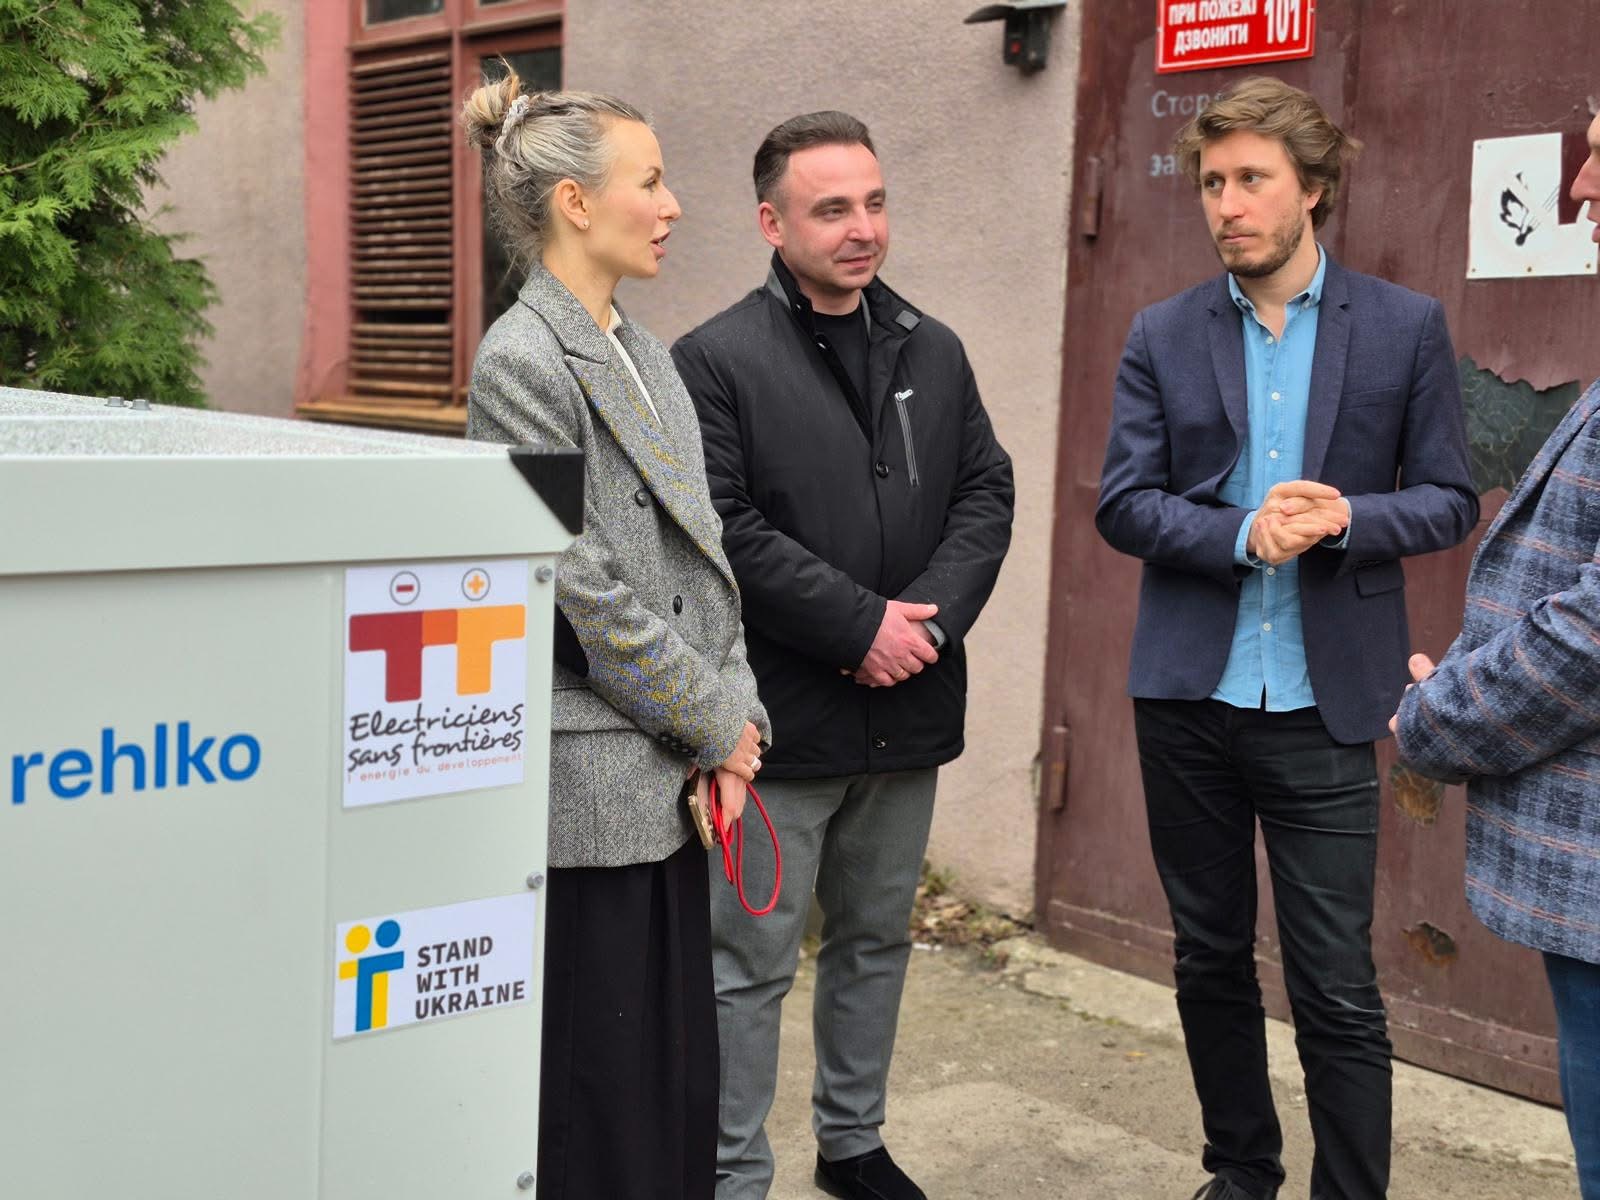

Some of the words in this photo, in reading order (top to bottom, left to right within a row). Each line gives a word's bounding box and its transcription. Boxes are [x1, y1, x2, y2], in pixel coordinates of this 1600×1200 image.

[1168, 2, 1195, 26] ПРИ
[1199, 0, 1258, 22] ПОЖЕЖІ
[1264, 0, 1301, 44] 101
[1173, 22, 1249, 56] ДЗВОНИТИ
[349, 703, 524, 741] Electriciens
[11, 720, 262, 805] rehlko
[347, 742, 404, 773] sans
[411, 727, 524, 767] frontières
[417, 935, 494, 968] STAND
[416, 963, 480, 994] WITH
[415, 980, 525, 1020] UKRAINE
